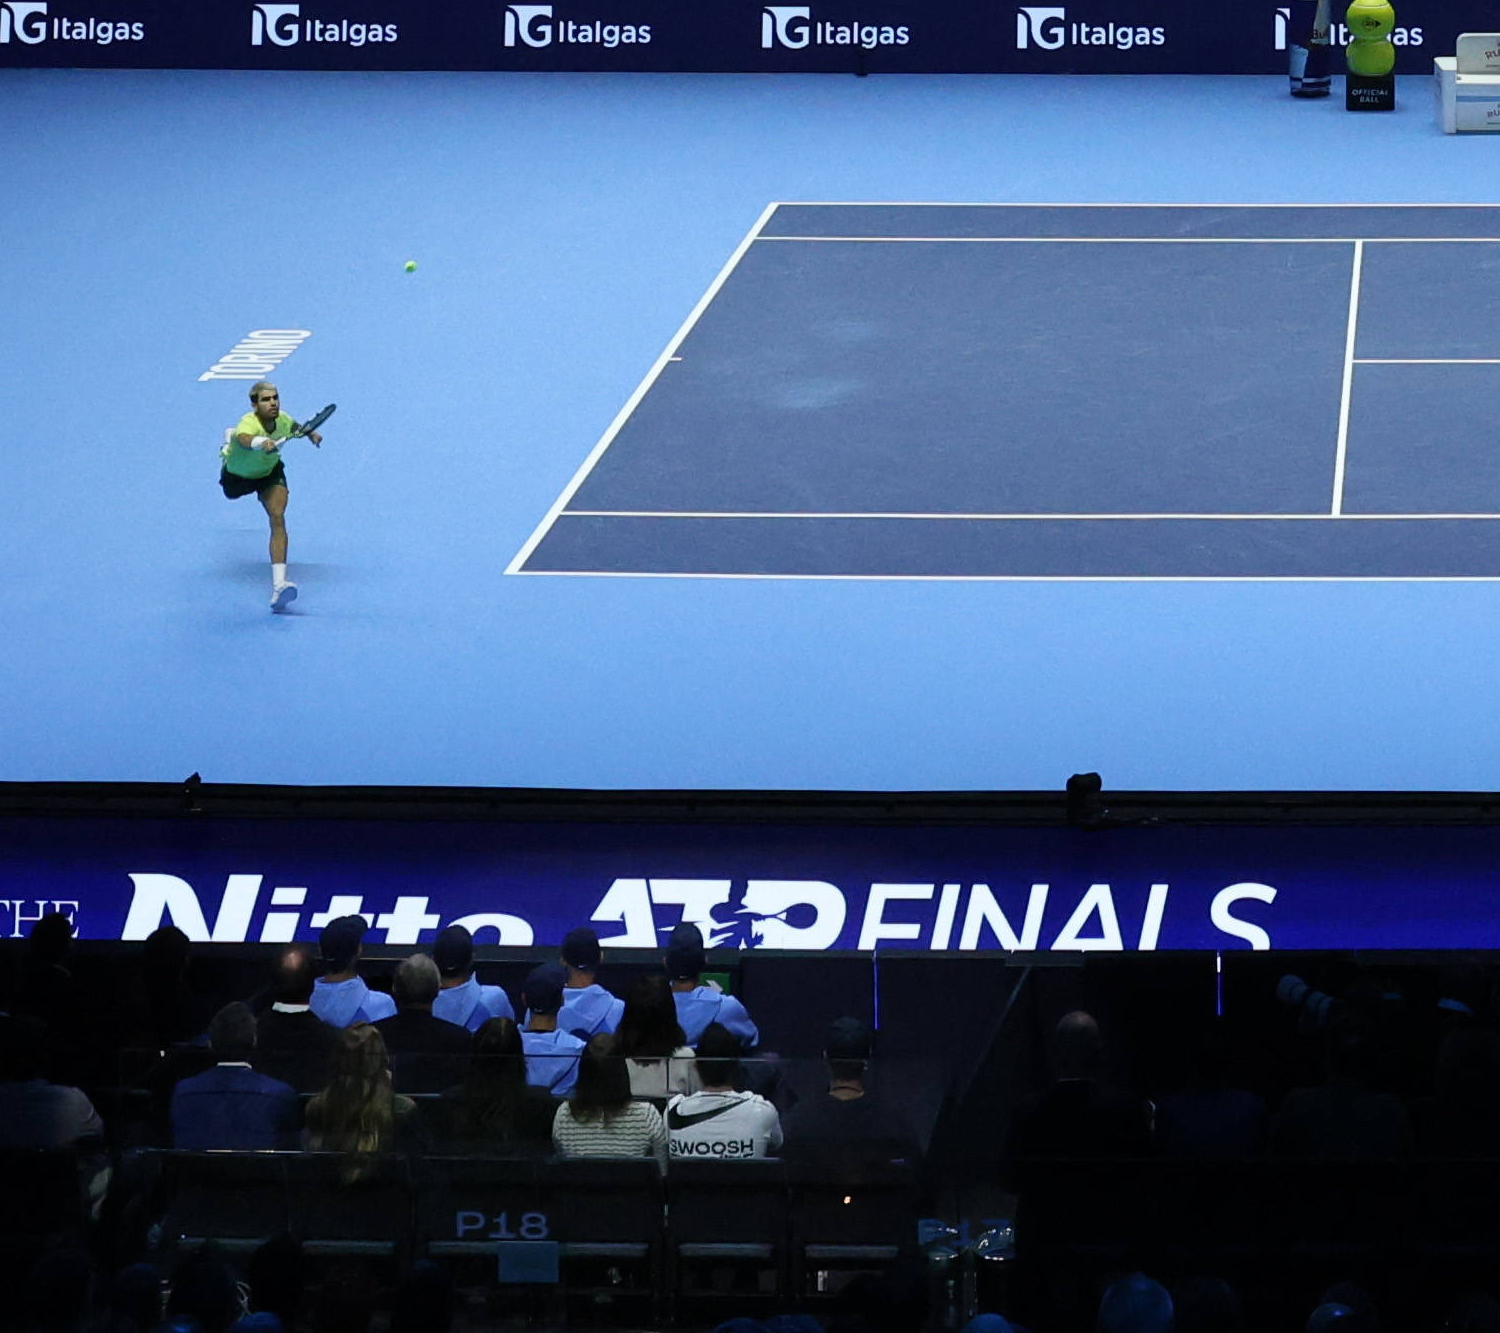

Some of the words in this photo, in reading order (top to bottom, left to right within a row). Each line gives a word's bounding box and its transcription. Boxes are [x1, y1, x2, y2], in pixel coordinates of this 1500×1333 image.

[53, 17, 144, 45] Italgas
[306, 19, 398, 47] Italgas
[559, 20, 651, 48] Italgas
[816, 21, 909, 49] Italgas
[1072, 22, 1165, 50] Italgas
[197, 328, 313, 382] TORINO
[120, 873, 534, 946] Nitto
[587, 878, 848, 953] ATP
[857, 882, 1279, 954] FINALS
[669, 1138, 755, 1156] SWOOSH
[455, 1209, 551, 1241] P18
